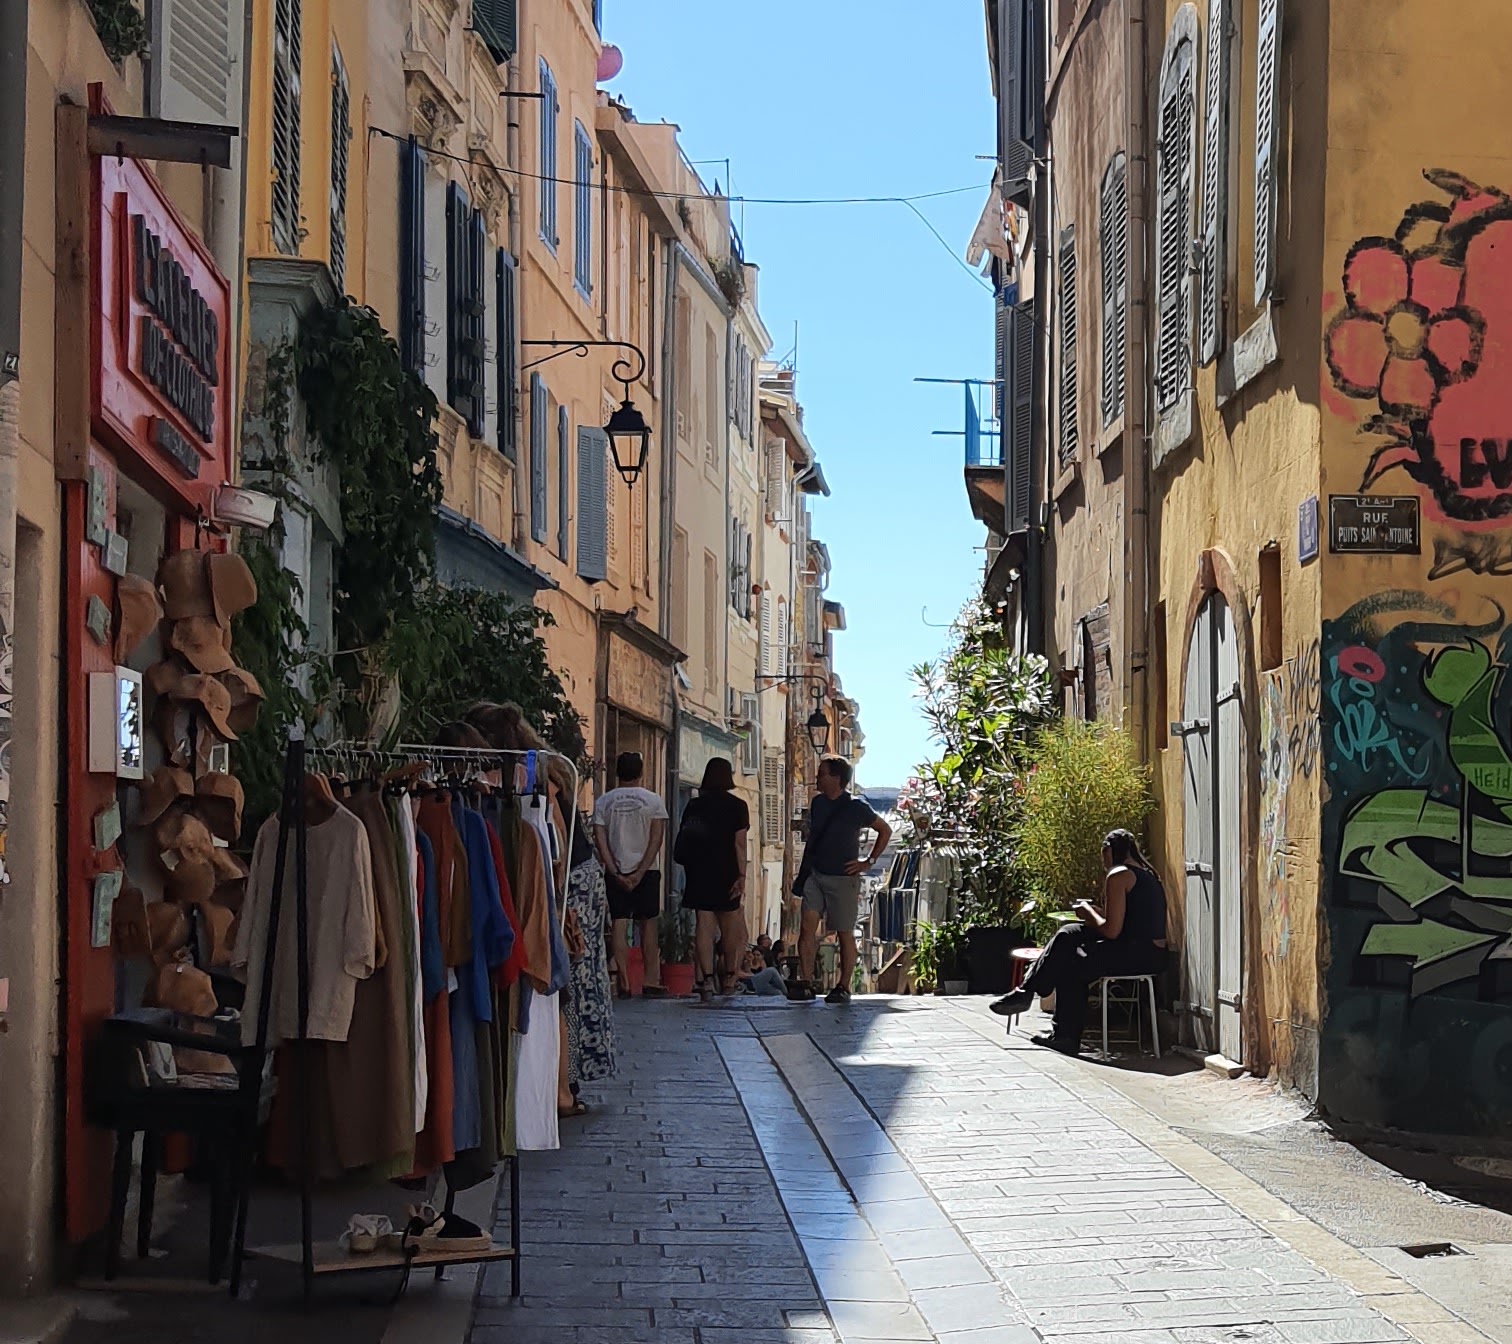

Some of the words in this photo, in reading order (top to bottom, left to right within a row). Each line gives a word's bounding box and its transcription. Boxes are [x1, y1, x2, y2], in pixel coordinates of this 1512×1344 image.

[1363, 512, 1389, 524] RUE
[1338, 527, 1358, 543] PUITS
[1361, 527, 1379, 543] SAIN
